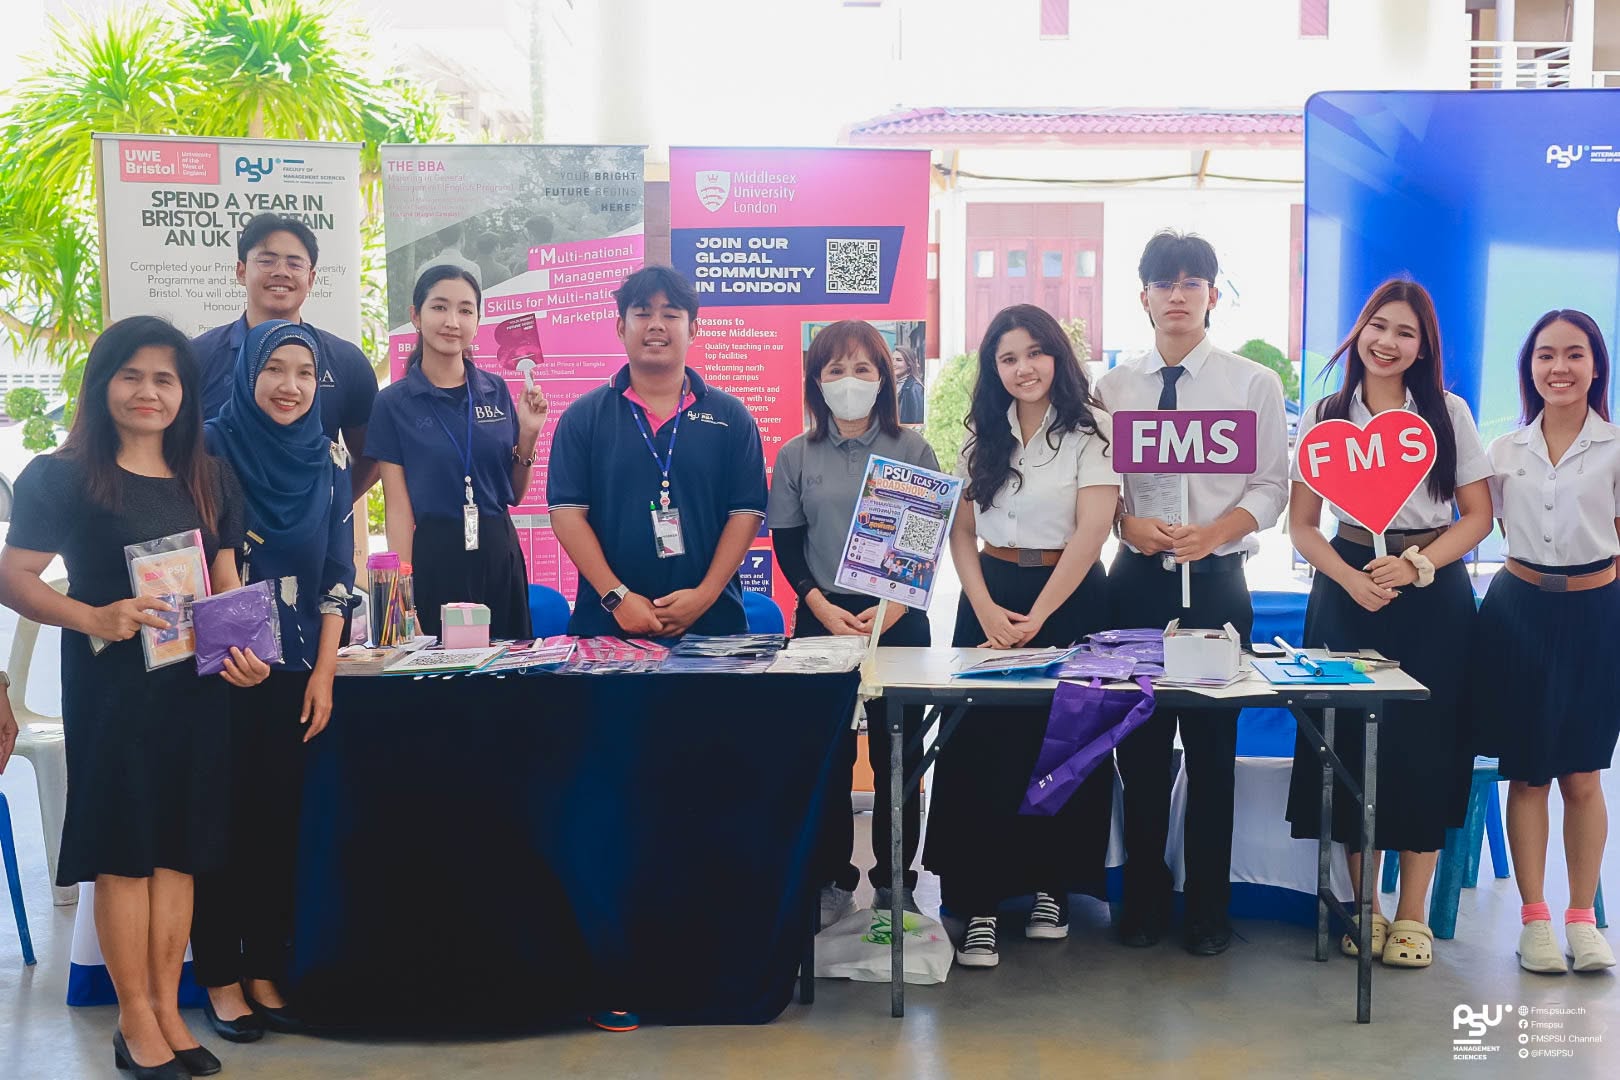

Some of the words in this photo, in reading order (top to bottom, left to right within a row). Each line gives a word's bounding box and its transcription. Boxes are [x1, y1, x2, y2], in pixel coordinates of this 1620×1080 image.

[124, 149, 161, 163] UWE
[181, 151, 212, 159] University
[1545, 144, 1583, 169] PSU
[125, 162, 175, 175] Bristol
[235, 156, 274, 183] PSU
[387, 160, 414, 172] THE
[417, 160, 446, 172] BBA
[594, 171, 637, 181] BRIGHT
[733, 170, 797, 185] Middlesex
[545, 187, 590, 197] FUTURE
[595, 187, 637, 197] BEGINS
[733, 185, 796, 201] University
[151, 190, 220, 209] SPEND
[224, 192, 241, 210] A
[244, 193, 298, 211] YEAR
[302, 194, 323, 212] IN
[733, 201, 777, 214] London
[141, 209, 223, 229] BRISTOL
[164, 229, 195, 247] AN
[201, 230, 232, 248] UK
[695, 237, 742, 249] JOIN
[748, 237, 789, 249] OUR
[695, 252, 773, 264] GLOBAL
[130, 261, 188, 274] Completed
[190, 263, 211, 274] your
[695, 267, 816, 279] COMMUNITY
[147, 274, 205, 287] Programme
[207, 275, 227, 285] and
[554, 265, 633, 285] Management
[149, 288, 183, 298] Bristol.
[185, 288, 203, 298] You
[206, 287, 222, 298] will
[695, 281, 715, 293] IN
[721, 281, 801, 293] LONDON
[203, 302, 241, 311] Honour
[487, 295, 522, 314] Skills
[526, 295, 544, 309] for
[696, 317, 732, 326] Reasons
[735, 317, 745, 326] to
[729, 328, 778, 337] Middlesex:
[705, 343, 730, 351] Quality
[731, 343, 762, 351] teaching
[705, 352, 717, 360] top
[718, 351, 748, 360] facilities
[704, 364, 744, 373] Welcoming
[745, 363, 765, 372] north
[704, 373, 731, 381] London
[732, 373, 759, 382] campus
[766, 385, 780, 393] and
[475, 404, 505, 419] BBA
[1132, 420, 1240, 464] FMS
[883, 464, 912, 483] PSU
[913, 475, 932, 488] TCAS
[932, 480, 950, 496] 70
[751, 556, 764, 568] 7
